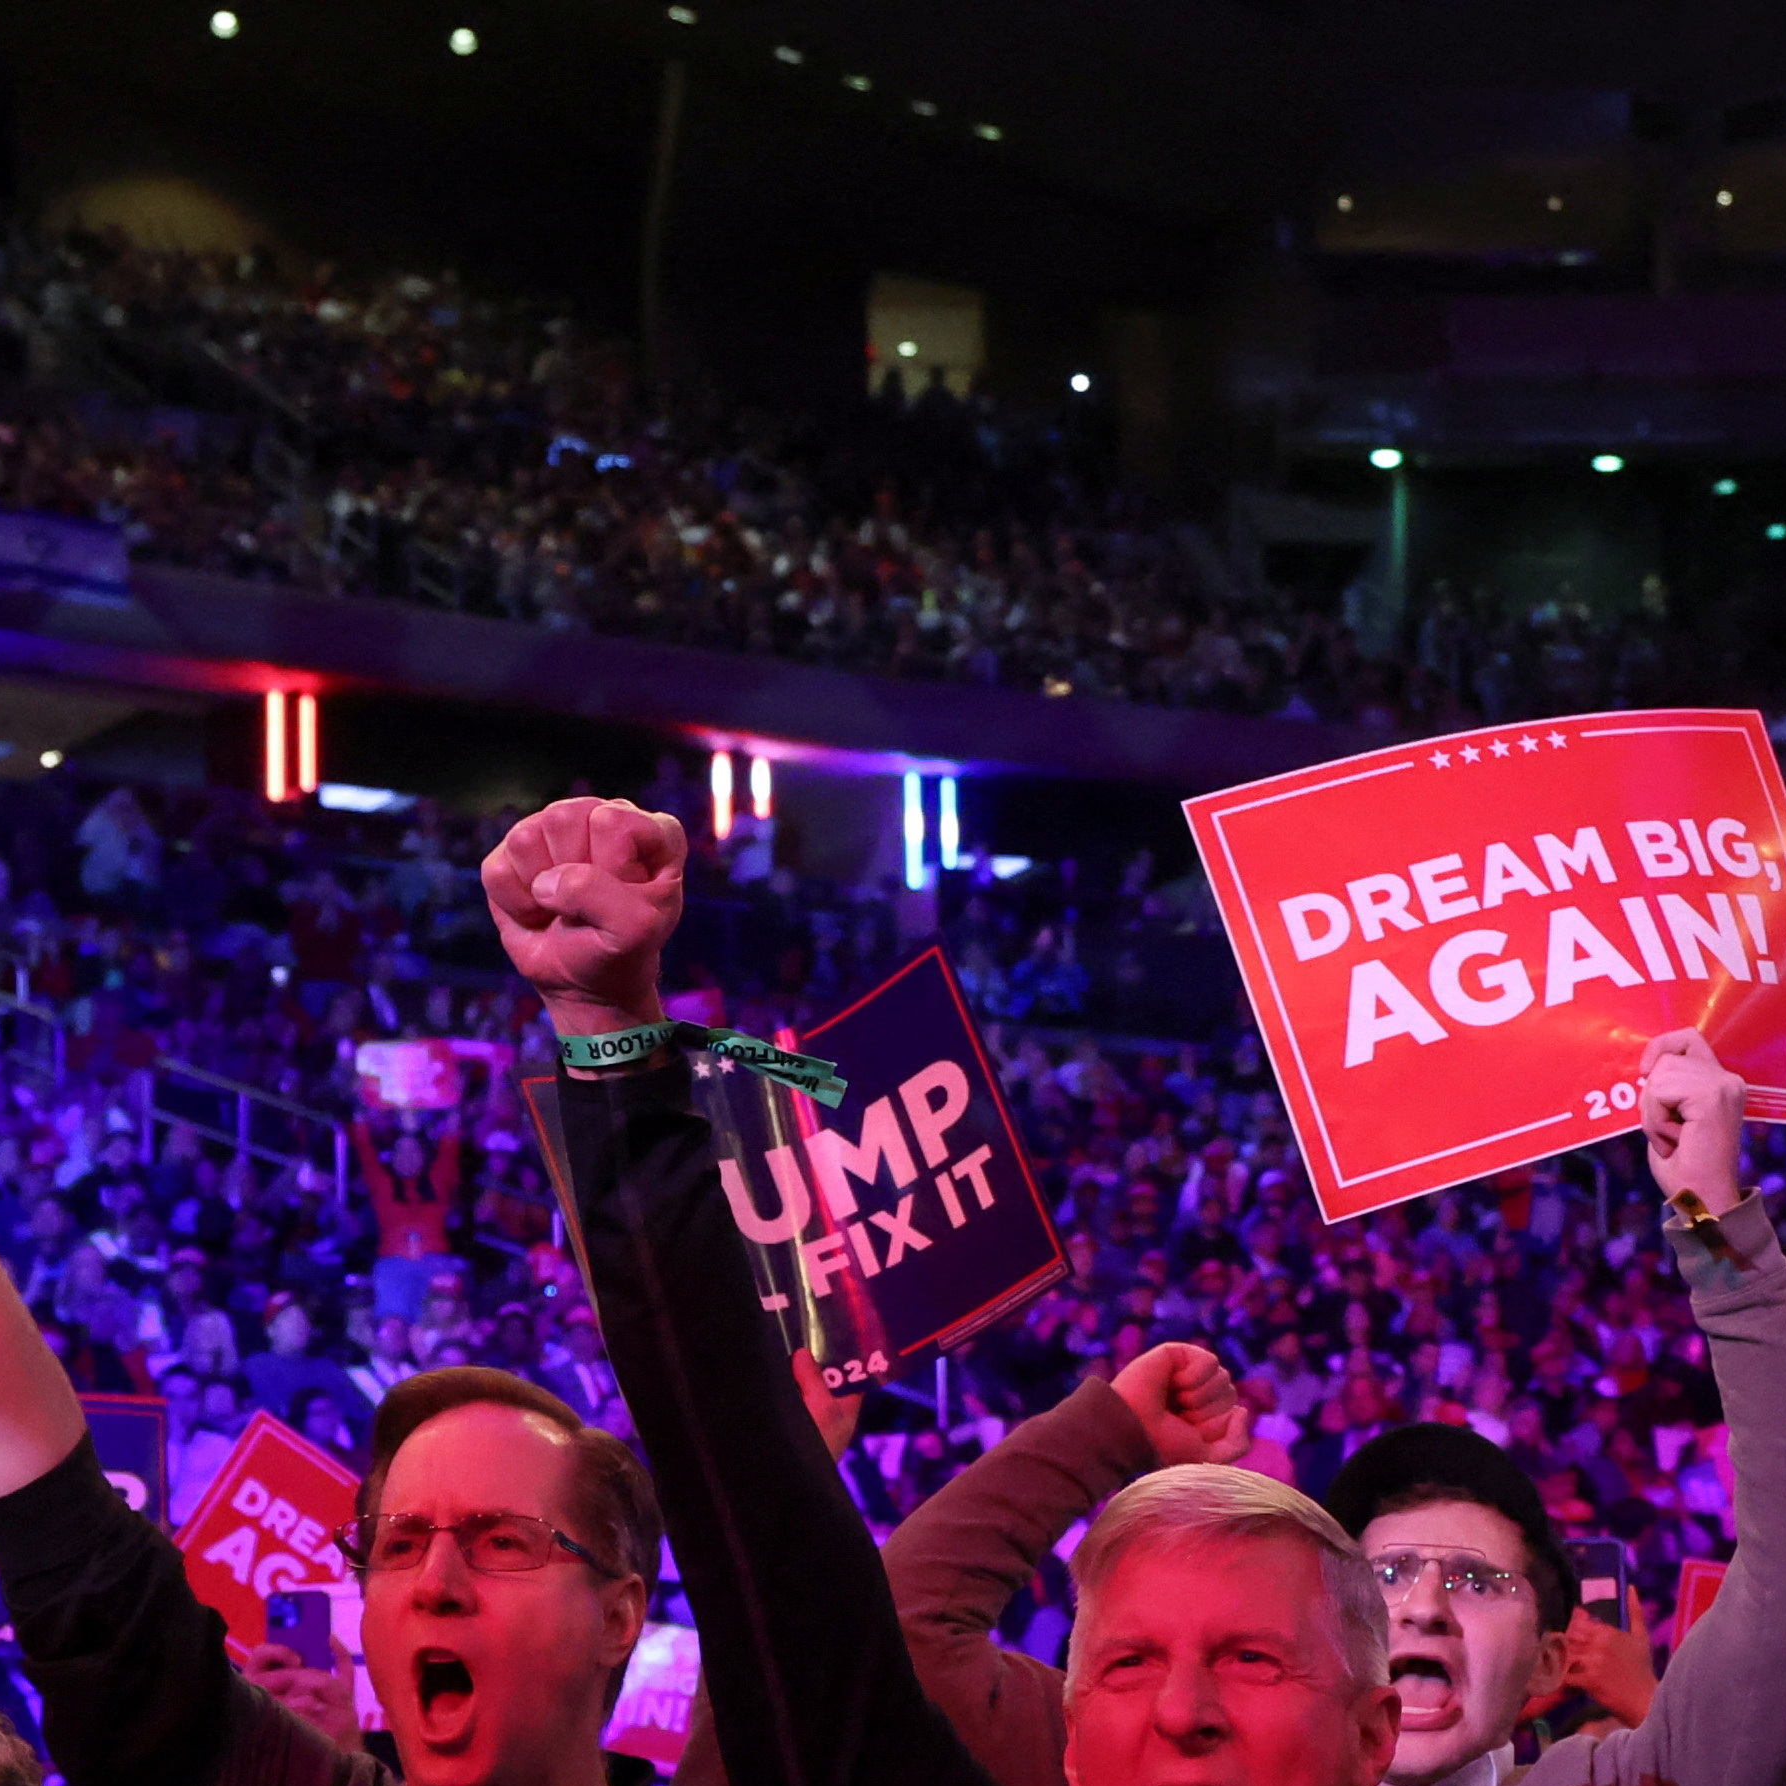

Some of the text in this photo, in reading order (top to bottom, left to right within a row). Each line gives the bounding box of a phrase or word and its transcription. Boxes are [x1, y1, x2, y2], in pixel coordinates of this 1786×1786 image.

[1278, 817, 1782, 961] DREAM BIG,
[1344, 893, 1778, 1069] AGAIN!
[1584, 1076, 1645, 1119] 20
[803, 1144, 995, 1298] FIX IT
